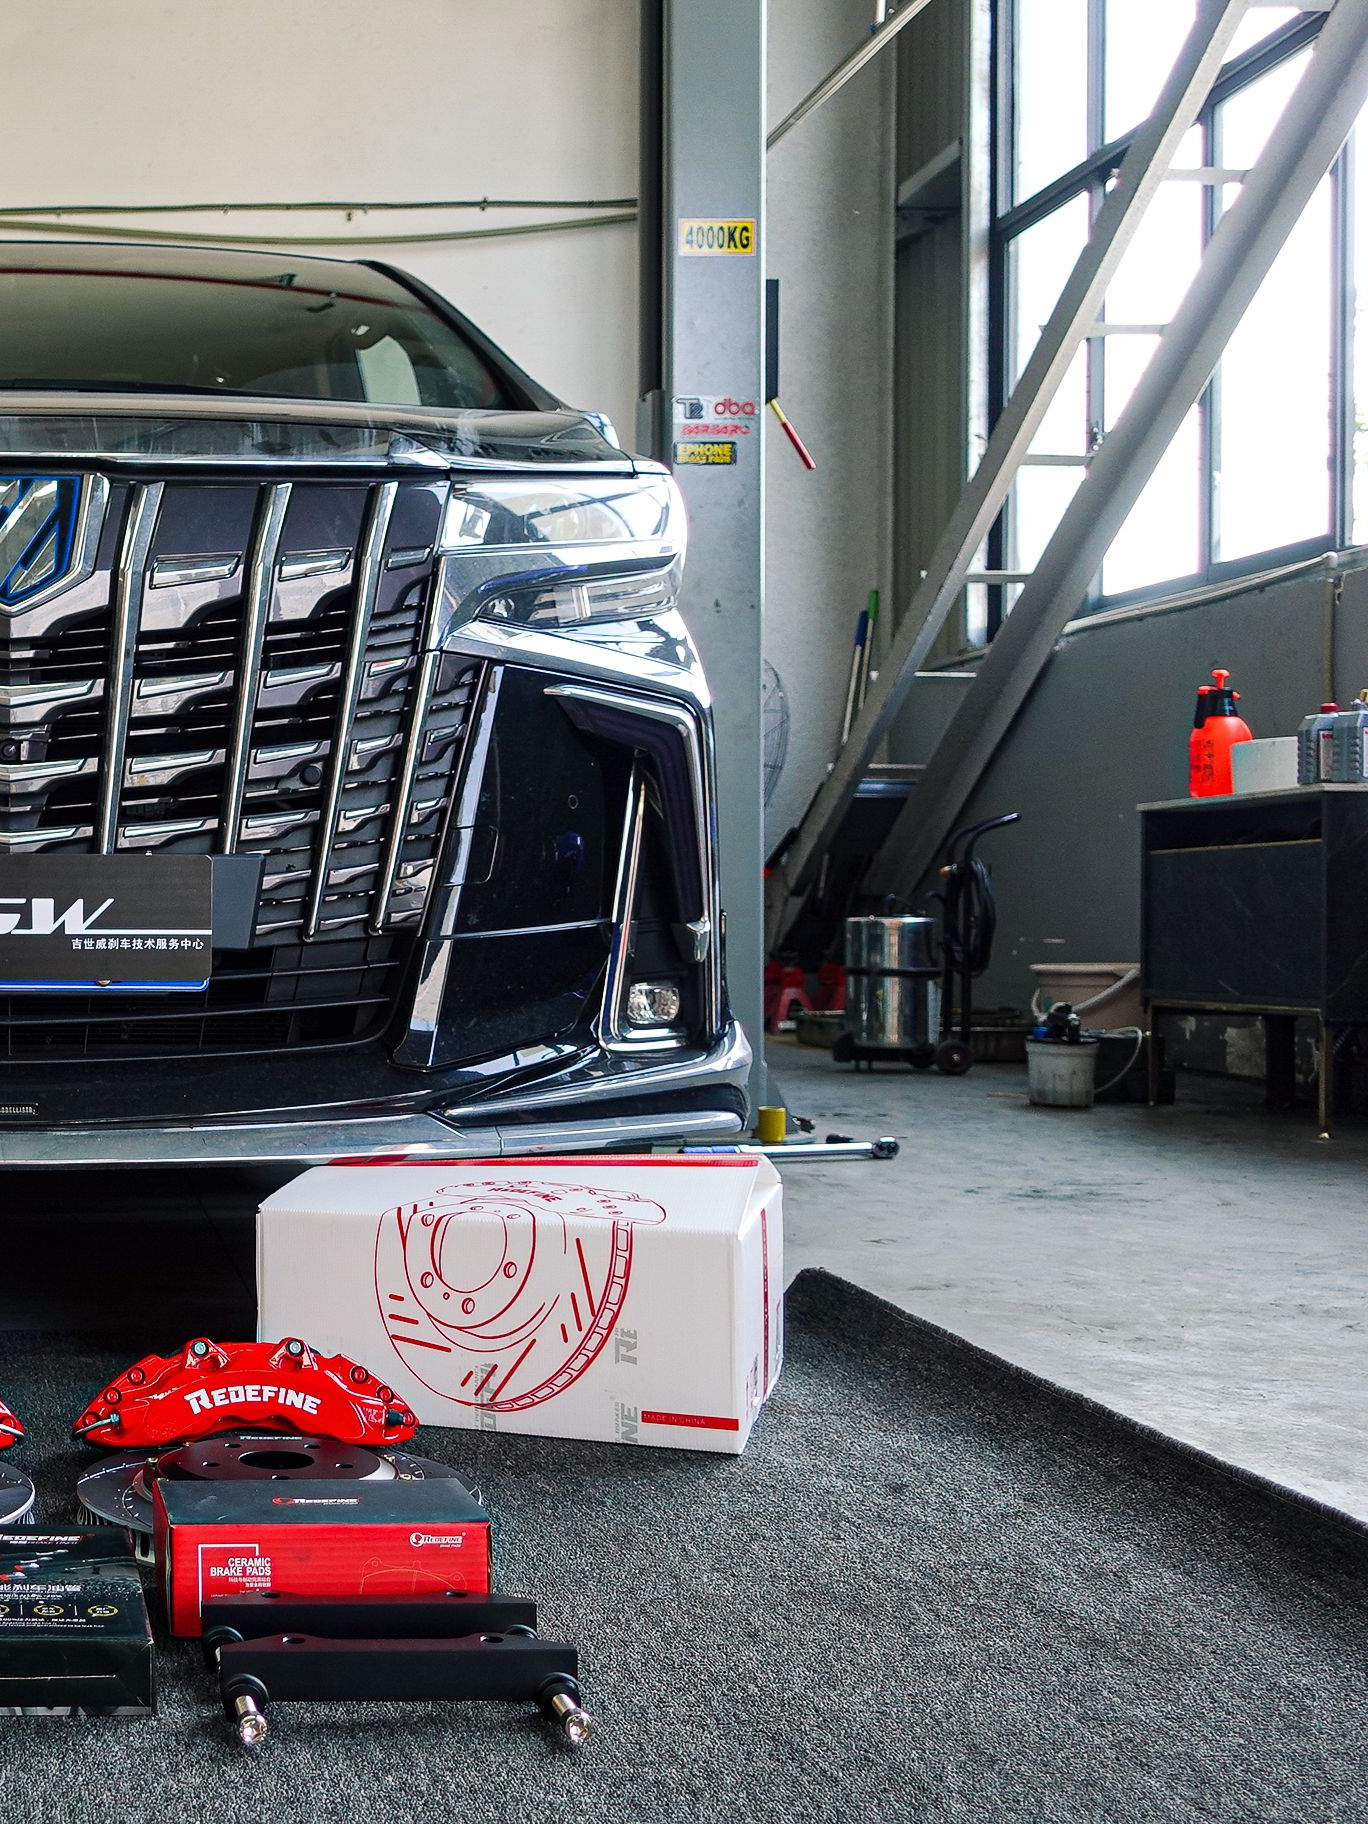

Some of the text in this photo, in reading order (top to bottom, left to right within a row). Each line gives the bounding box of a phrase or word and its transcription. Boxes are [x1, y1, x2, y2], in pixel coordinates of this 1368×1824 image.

[685, 225, 750, 249] 4000KG
[714, 398, 756, 416] dba
[71, 937, 205, 950] 吉世威刹车技术服务中心
[184, 1384, 322, 1415] REDEFINE
[643, 1413, 667, 1422] MADE
[680, 1417, 706, 1426] CHINA
[423, 1535, 462, 1544] REDEFINE
[228, 1558, 271, 1567] CERAMIC
[210, 1567, 271, 1576] BRAKE PADS
